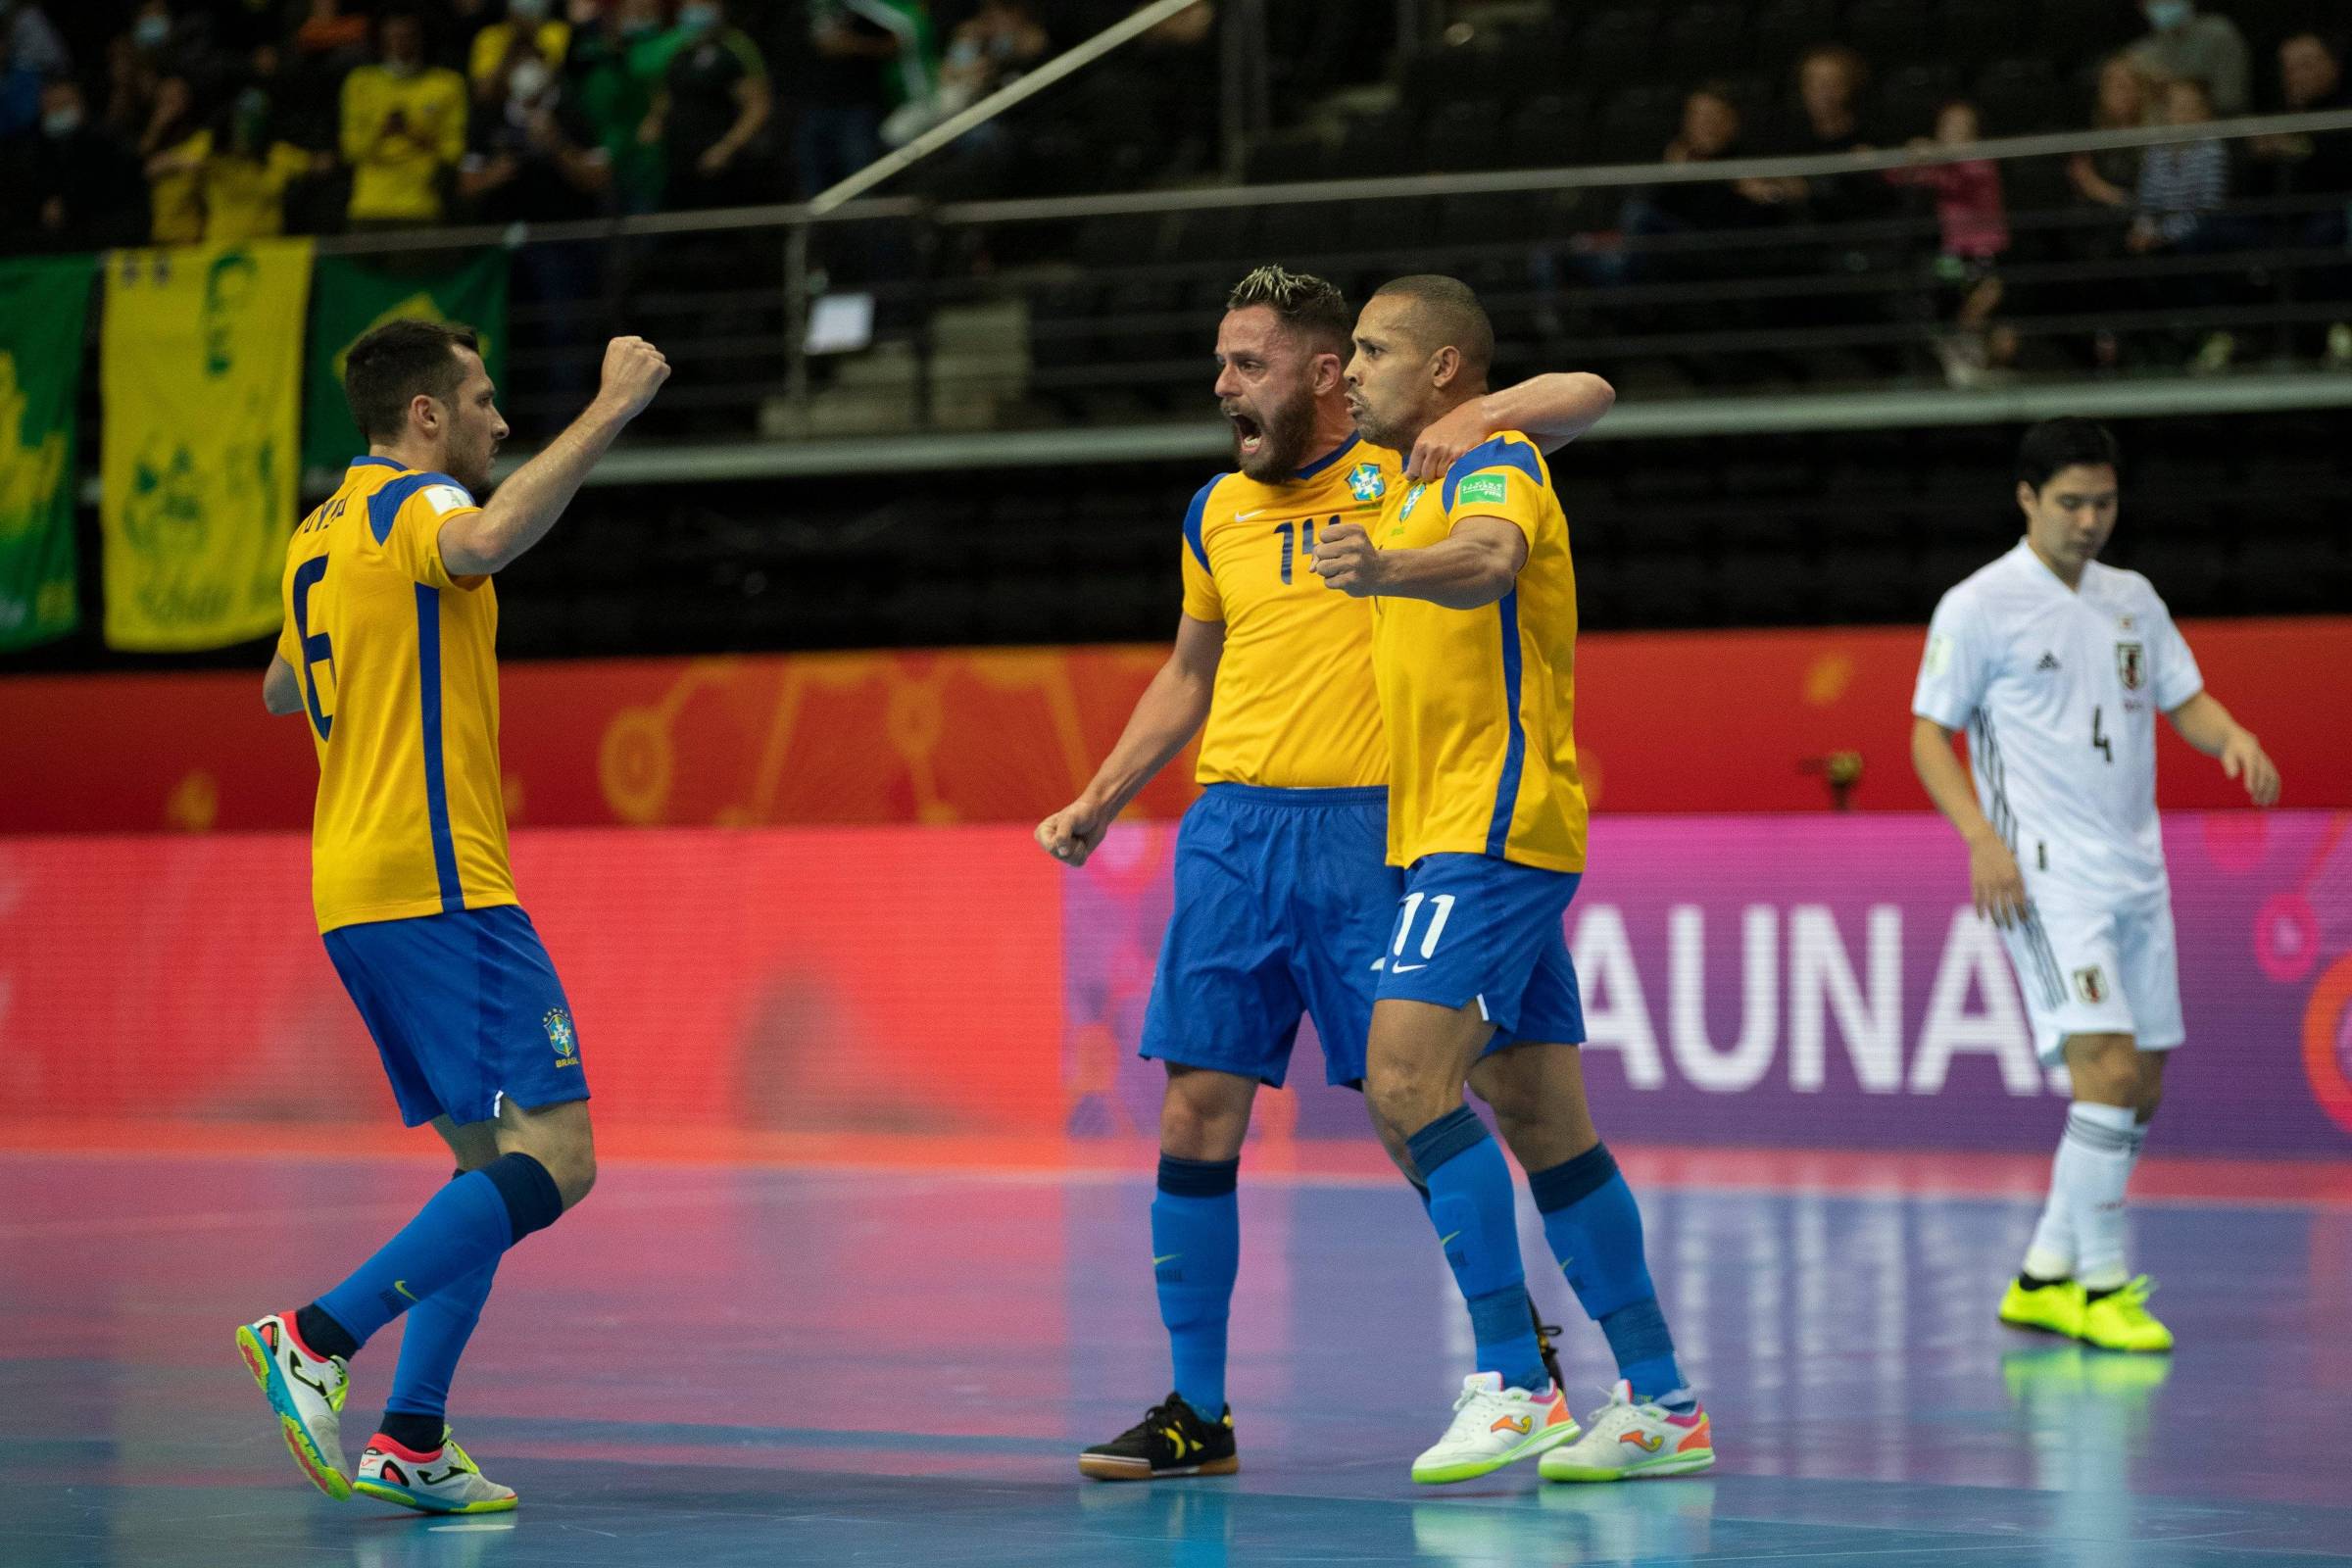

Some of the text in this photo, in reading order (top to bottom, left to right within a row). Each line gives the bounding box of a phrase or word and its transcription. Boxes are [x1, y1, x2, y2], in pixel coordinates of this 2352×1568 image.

[2092, 705, 2113, 763] 4
[1393, 892, 1455, 959] 11
[1571, 906, 2073, 1097] AUNA
